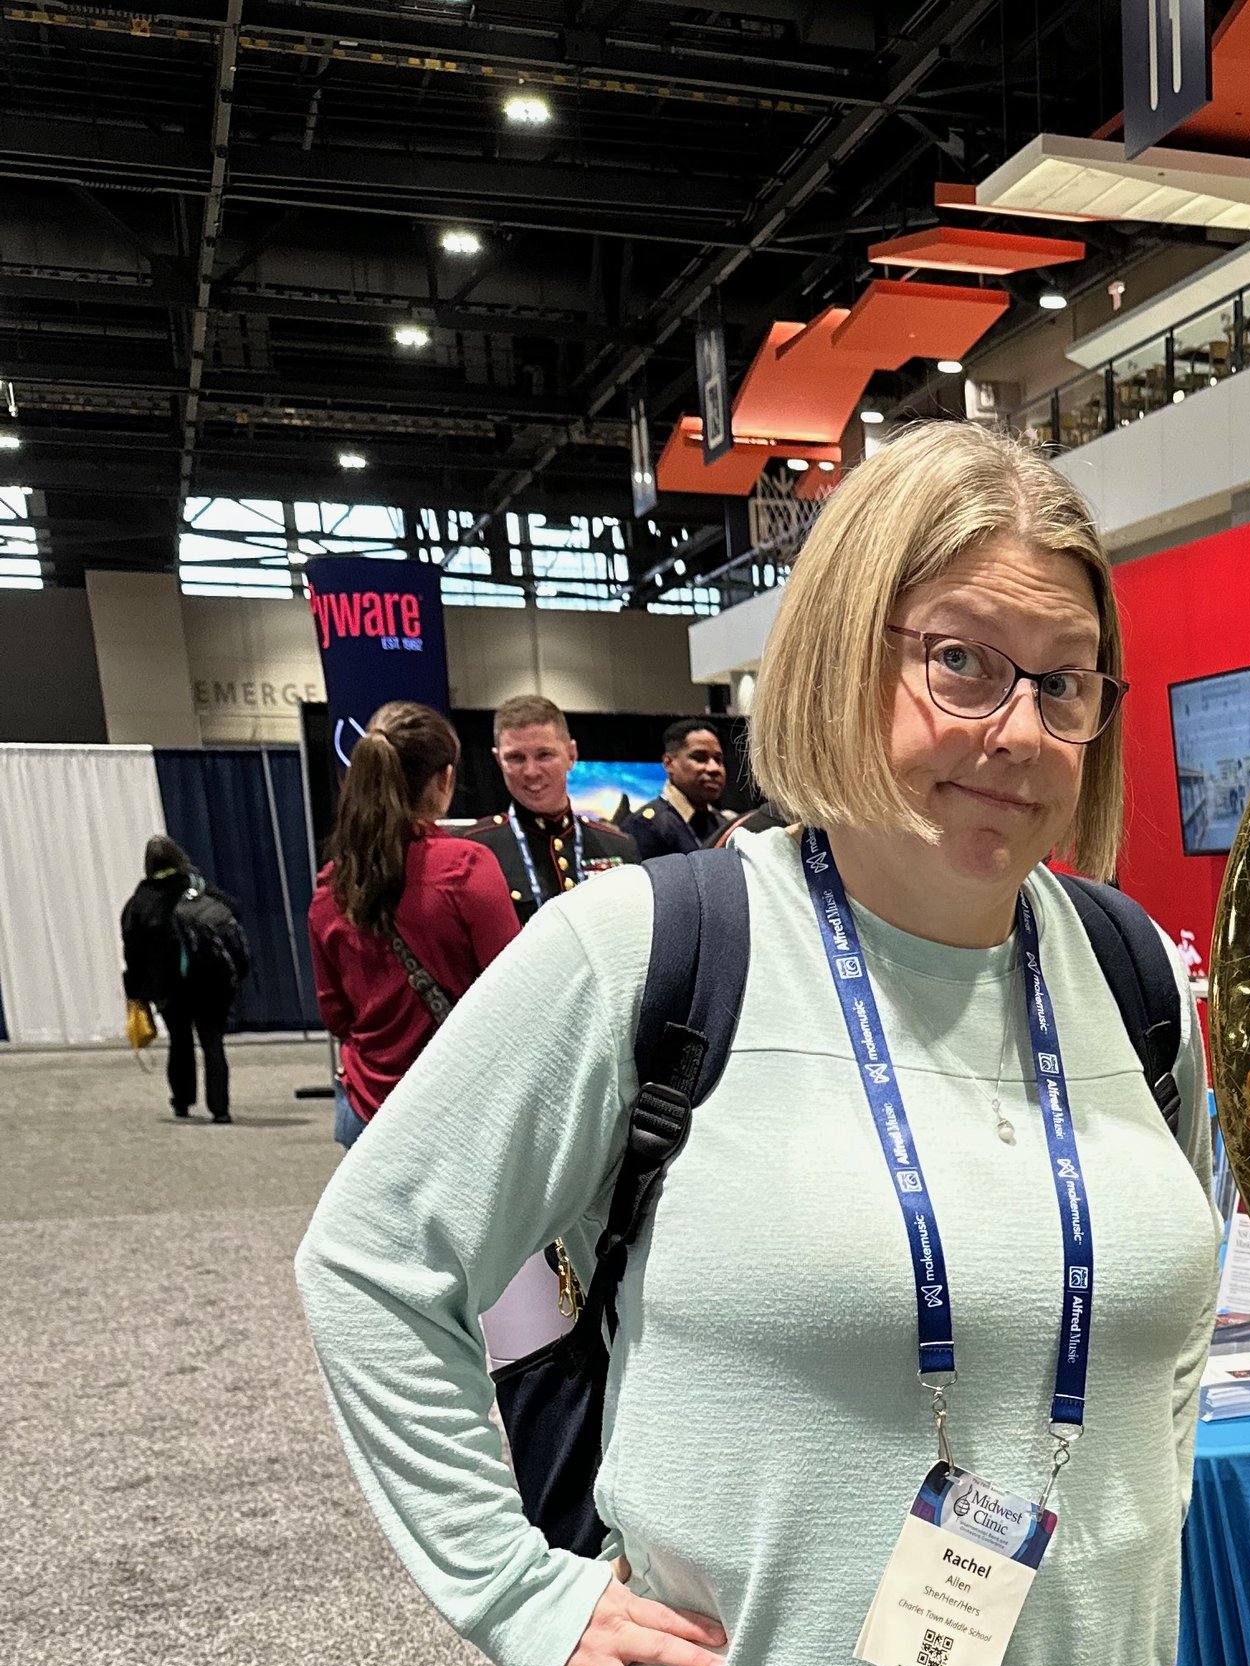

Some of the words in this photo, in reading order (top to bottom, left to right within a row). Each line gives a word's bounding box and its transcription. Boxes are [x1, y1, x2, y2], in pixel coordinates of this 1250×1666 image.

[829, 917, 850, 951] Alfred
[1032, 972, 1047, 1032] makemusic
[853, 1000, 878, 1061] makemusic
[1046, 1078, 1061, 1111] Alfred
[1066, 1179, 1083, 1242] makemusic
[913, 1213, 935, 1281] makemusic
[1071, 1295, 1082, 1331] Alfred
[1067, 1330, 1081, 1364] Music
[971, 1490, 1023, 1525] Midwest
[973, 1510, 1009, 1536] Clinic
[942, 1547, 992, 1579] Rachel
[922, 1585, 982, 1617] She/Her/Hers
[945, 1575, 972, 1593] Allen
[898, 1598, 925, 1616] Charles
[925, 1609, 945, 1623] Town
[943, 1617, 969, 1633] Middle
[968, 1627, 993, 1645] School
